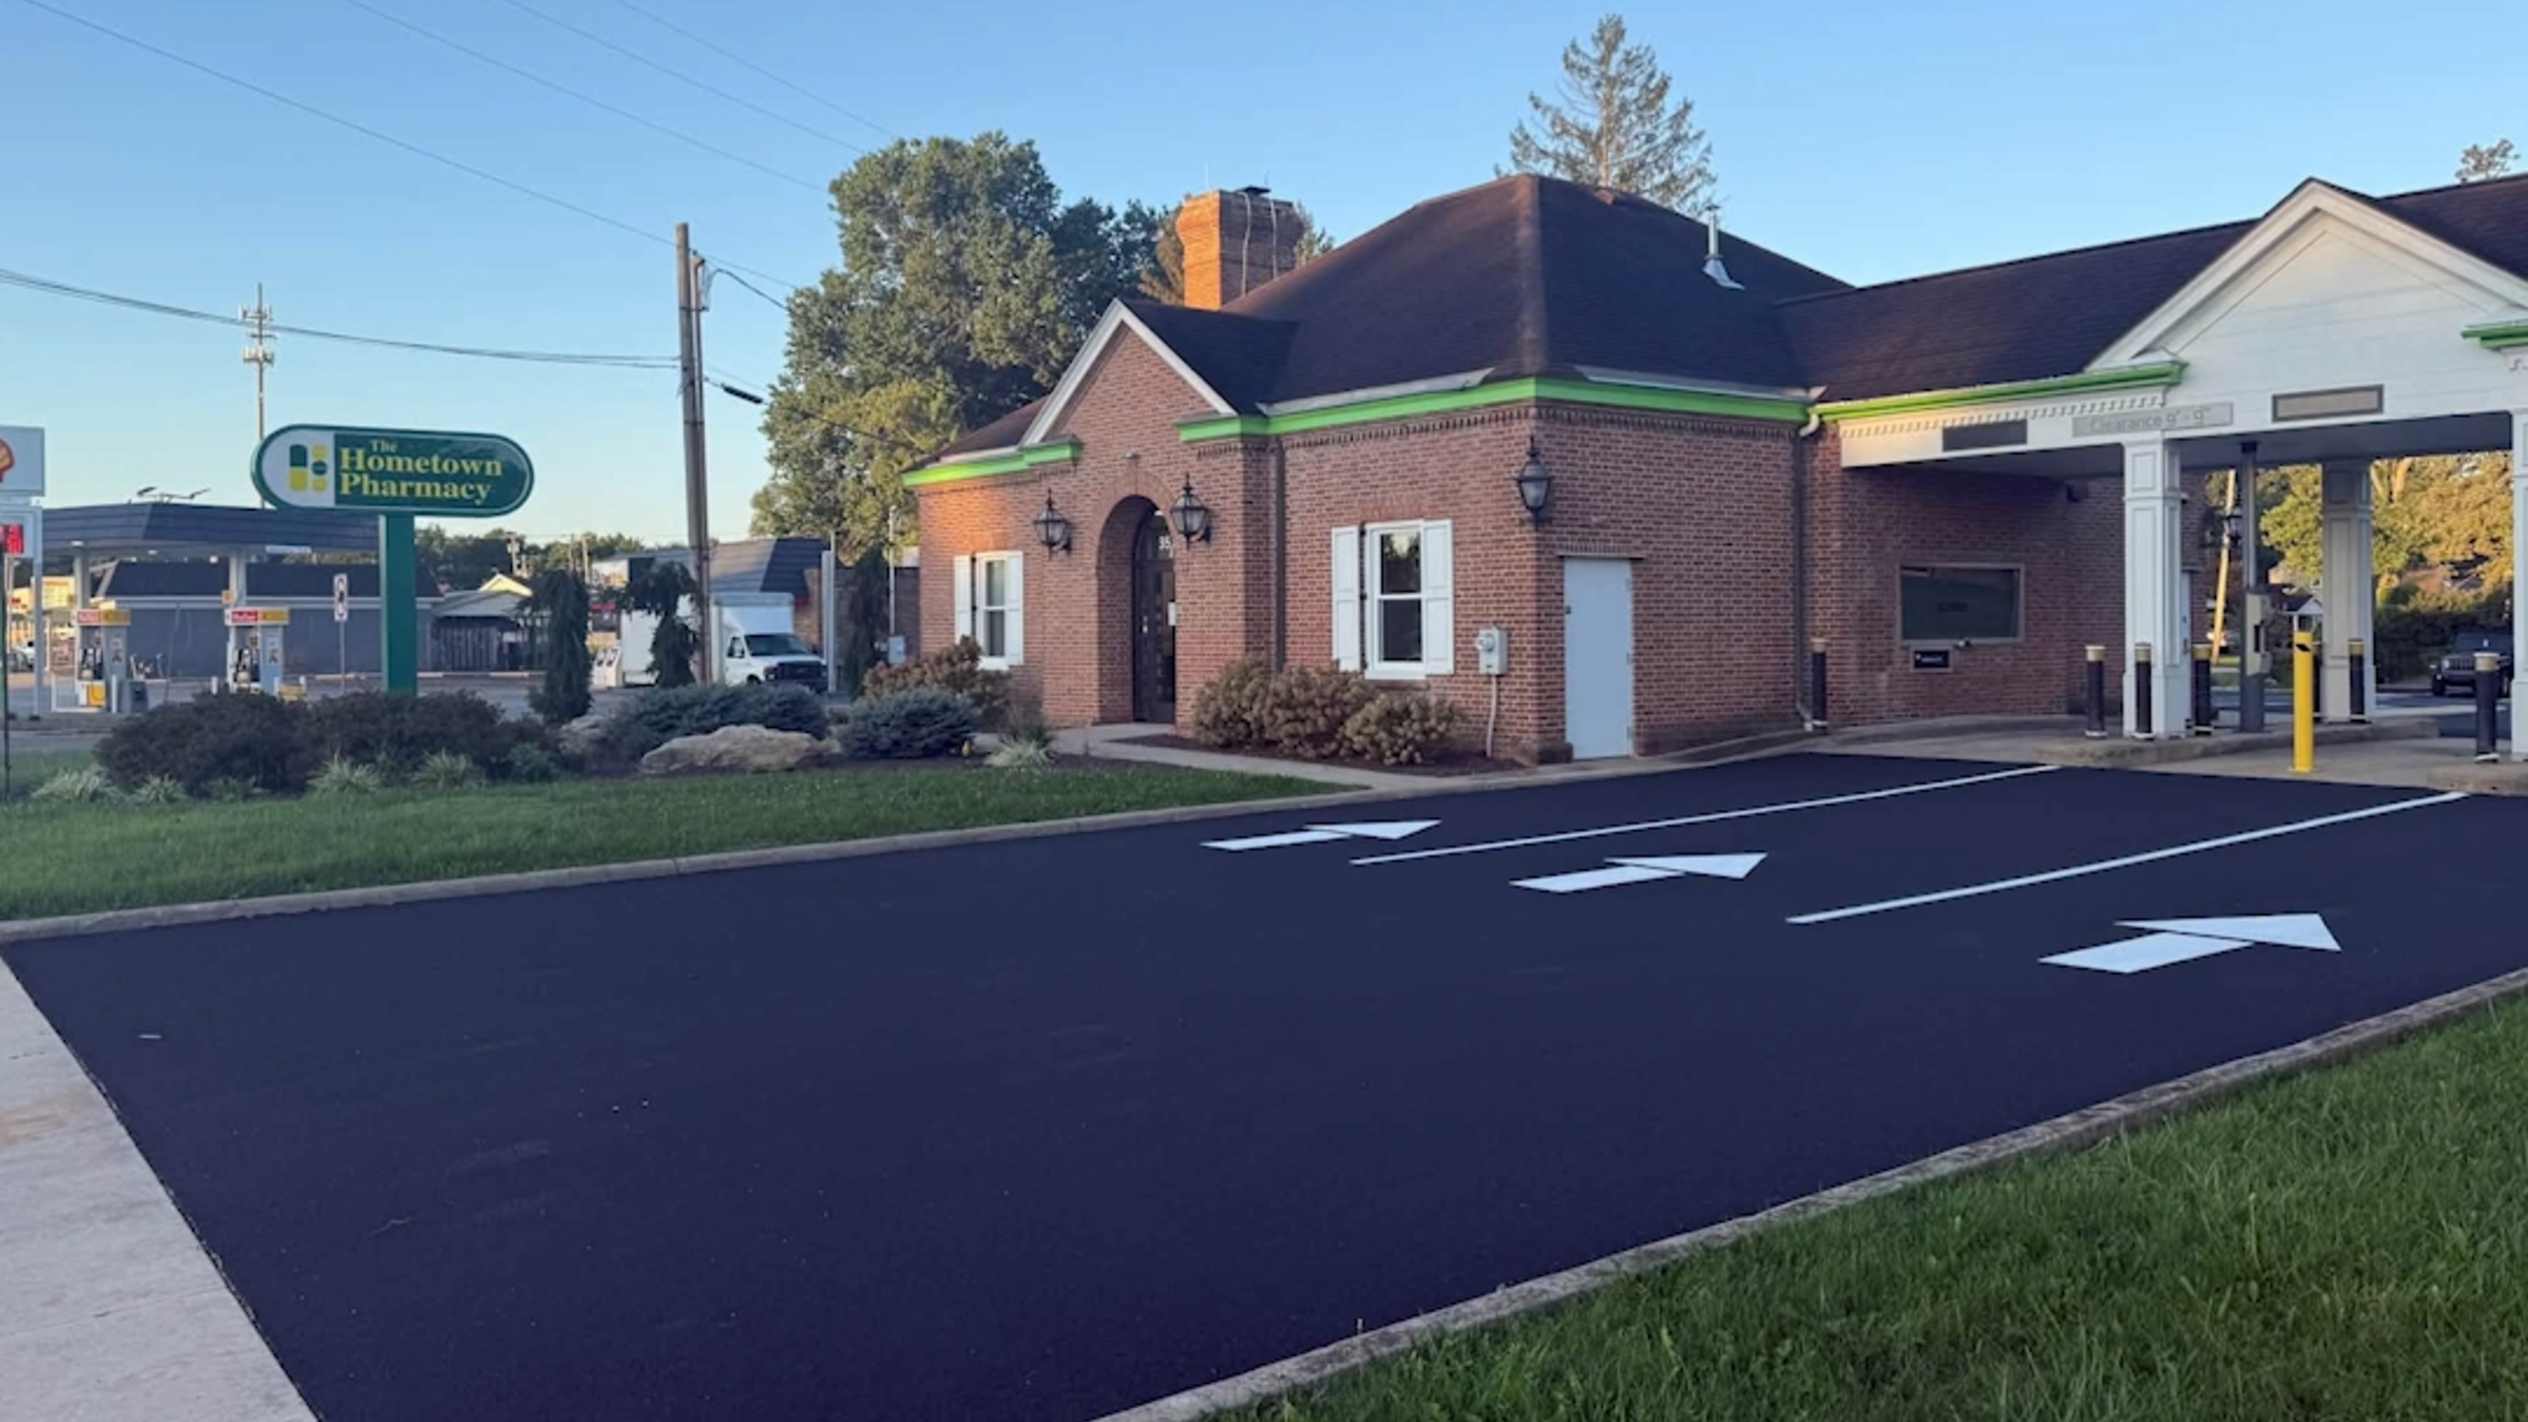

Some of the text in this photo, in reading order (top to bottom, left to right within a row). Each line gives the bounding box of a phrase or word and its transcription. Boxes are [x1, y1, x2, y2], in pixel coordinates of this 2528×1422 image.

[2090, 413, 2163, 433] Clearance
[370, 439, 398, 453] The
[340, 447, 503, 477] Hometown
[340, 472, 491, 505] Pharmacy
